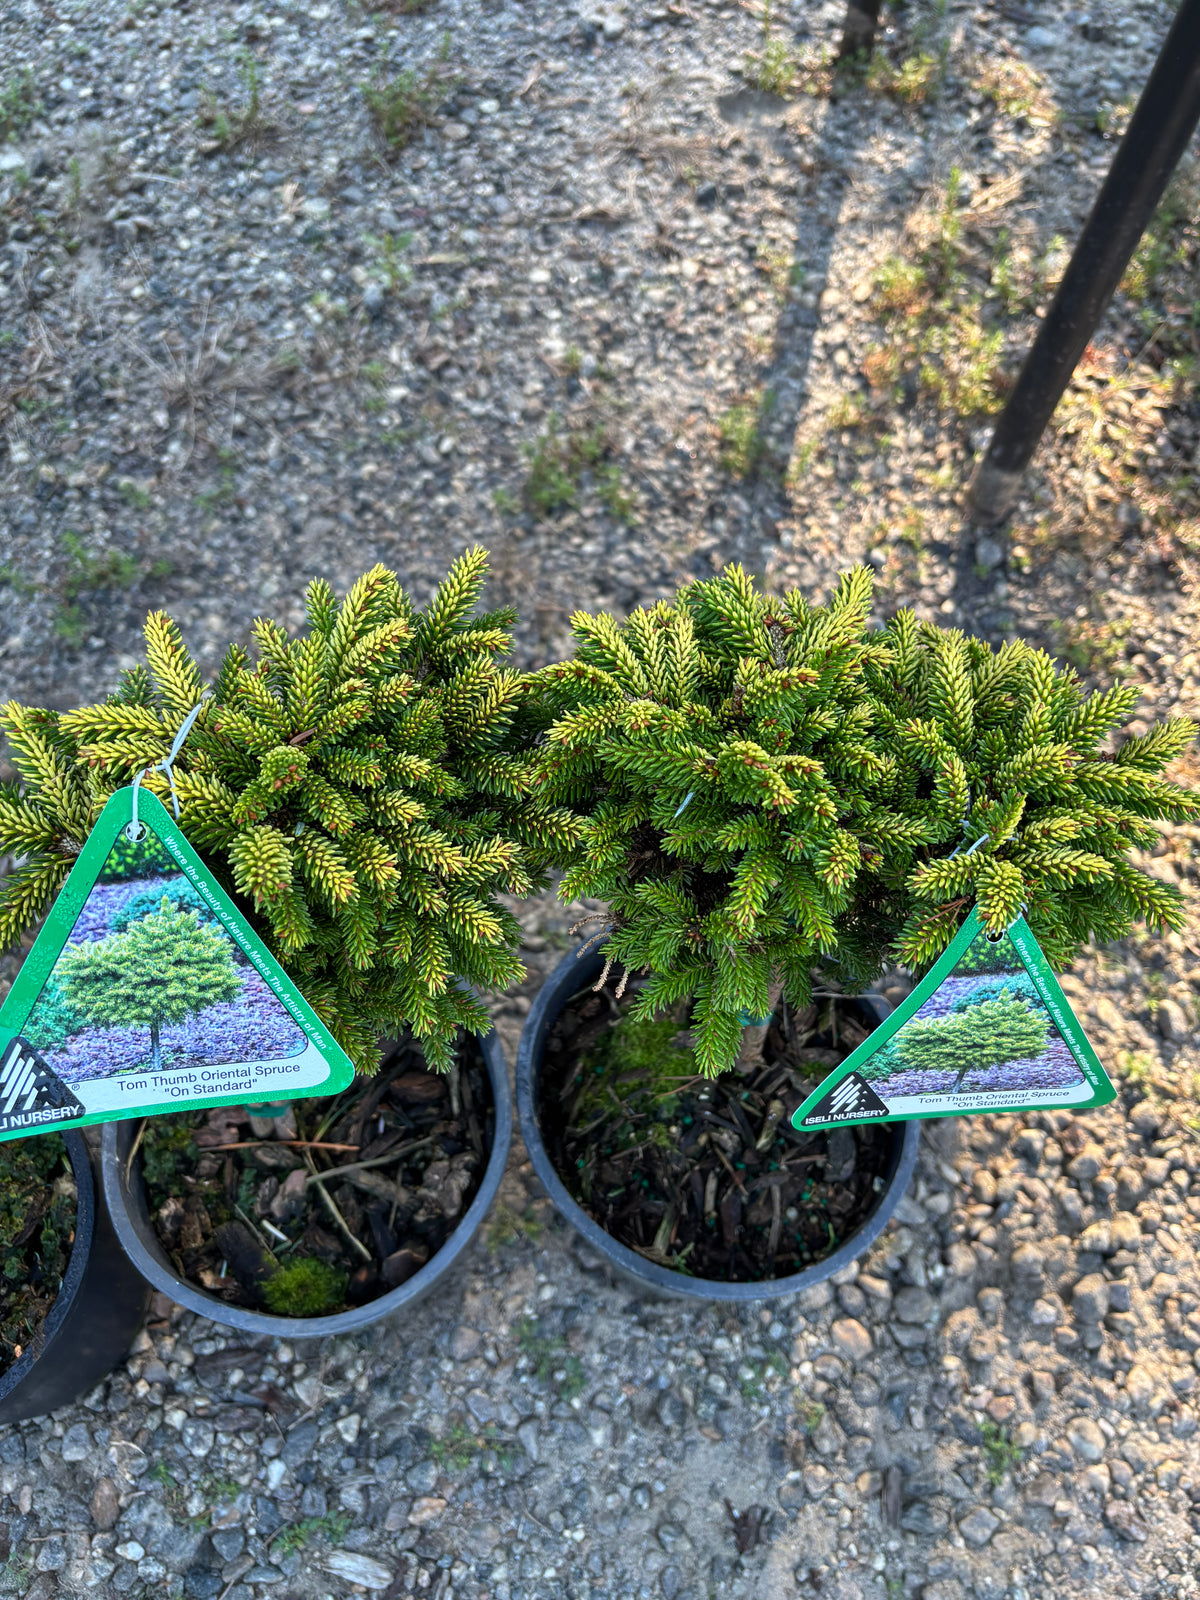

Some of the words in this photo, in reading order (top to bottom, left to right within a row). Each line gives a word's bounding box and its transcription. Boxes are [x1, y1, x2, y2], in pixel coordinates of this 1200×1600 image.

[165, 836, 188, 866] Where
[186, 866, 199, 881] the
[198, 881, 223, 911] Beauty
[220, 911, 232, 922] of
[227, 921, 252, 951] Nature
[250, 950, 271, 976] Meets
[269, 975, 284, 993] The
[281, 992, 307, 1023] Artistry
[304, 1023, 315, 1032] of
[1015, 938, 1031, 962] Where
[1029, 963, 1038, 976] the
[1036, 977, 1051, 1000] Beauty
[1048, 1000, 1058, 1008] of
[1053, 1008, 1067, 1028] Nature
[1063, 1028, 1076, 1045] Meets
[1072, 1044, 1082, 1054] The
[117, 1079, 148, 1092] Tom
[152, 1073, 198, 1088] Thumb
[201, 1066, 252, 1083] Oriental
[255, 1063, 301, 1080] Spruce
[164, 1085, 190, 1098] "On
[193, 1078, 258, 1096] Standard"
[918, 1096, 943, 1104] Tom
[945, 1094, 983, 1103] Thumb
[985, 1091, 1029, 1100] Oriental
[1031, 1090, 1070, 1099] Spruce
[975, 1097, 1031, 1107] Standard"
[10, 1105, 80, 1127] NURSERY
[805, 1114, 832, 1125] ISELI
[833, 1109, 886, 1121] NURSERY
